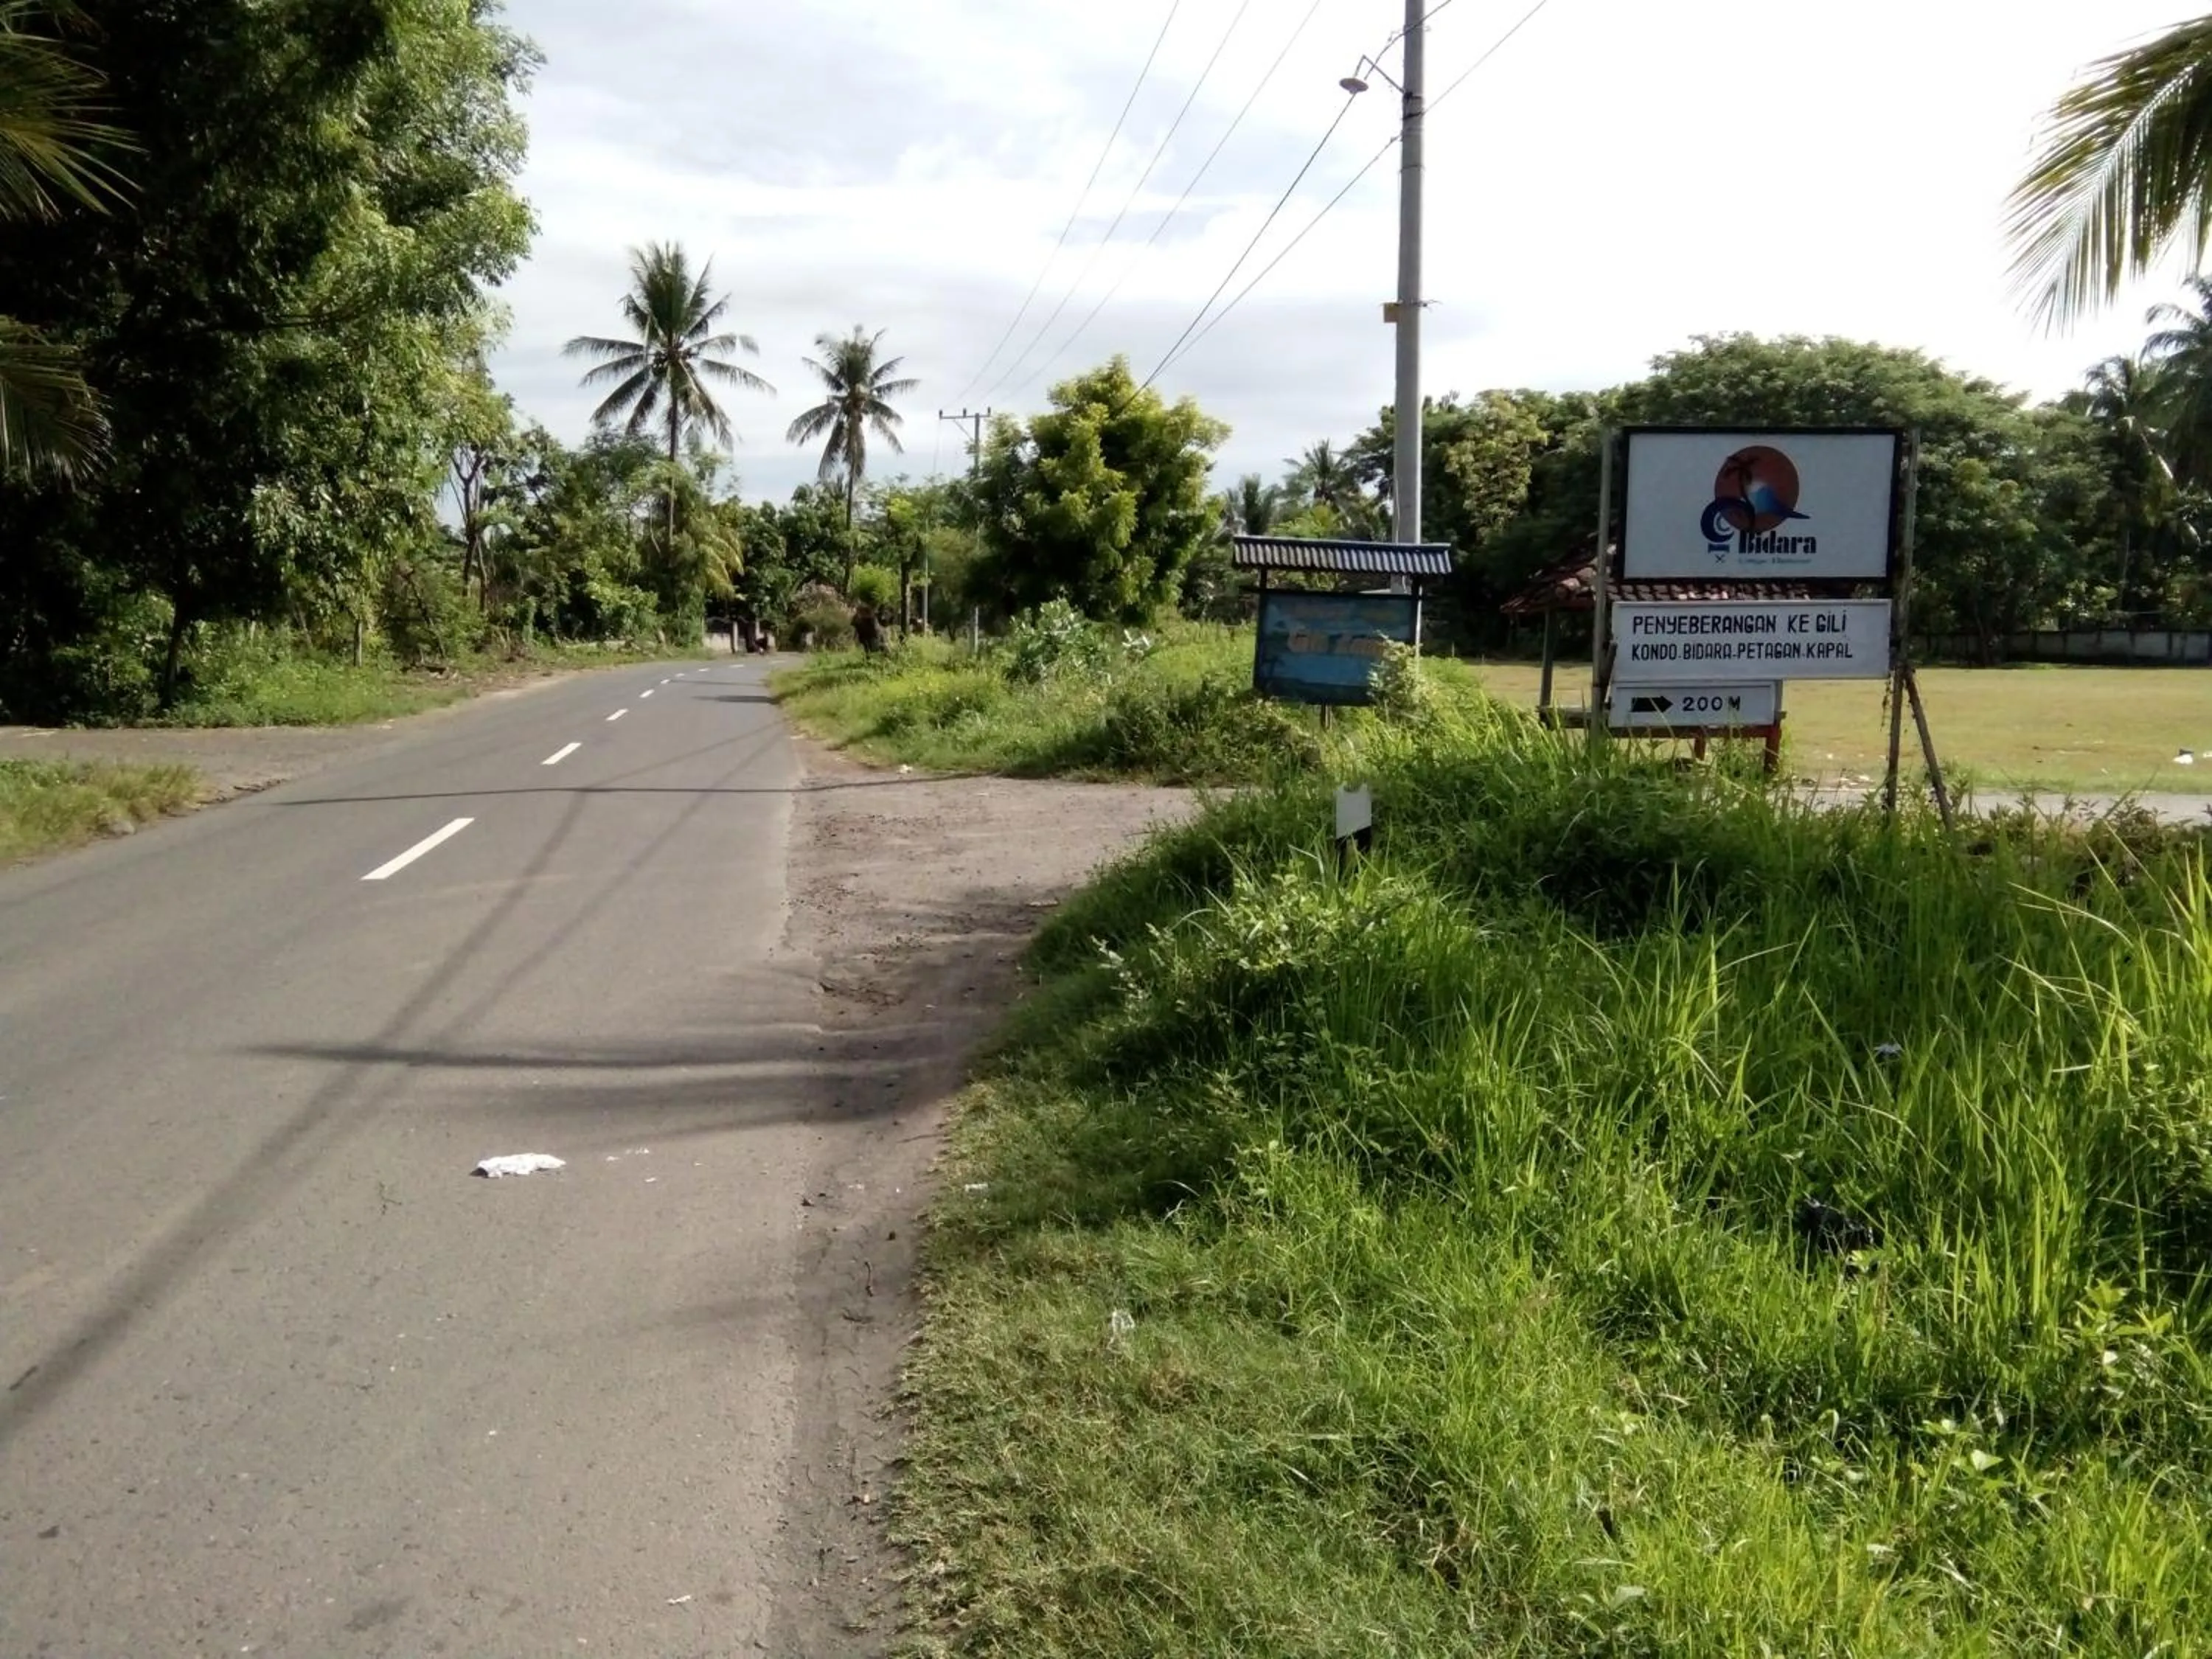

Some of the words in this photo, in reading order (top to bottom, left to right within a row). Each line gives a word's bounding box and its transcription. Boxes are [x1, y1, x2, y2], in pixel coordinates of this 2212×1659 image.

[1738, 530, 1818, 554] Bidara
[1632, 614, 1776, 635] PENYEBERANGAN
[1787, 614, 1809, 633] KE
[1683, 696, 1723, 712] 200
